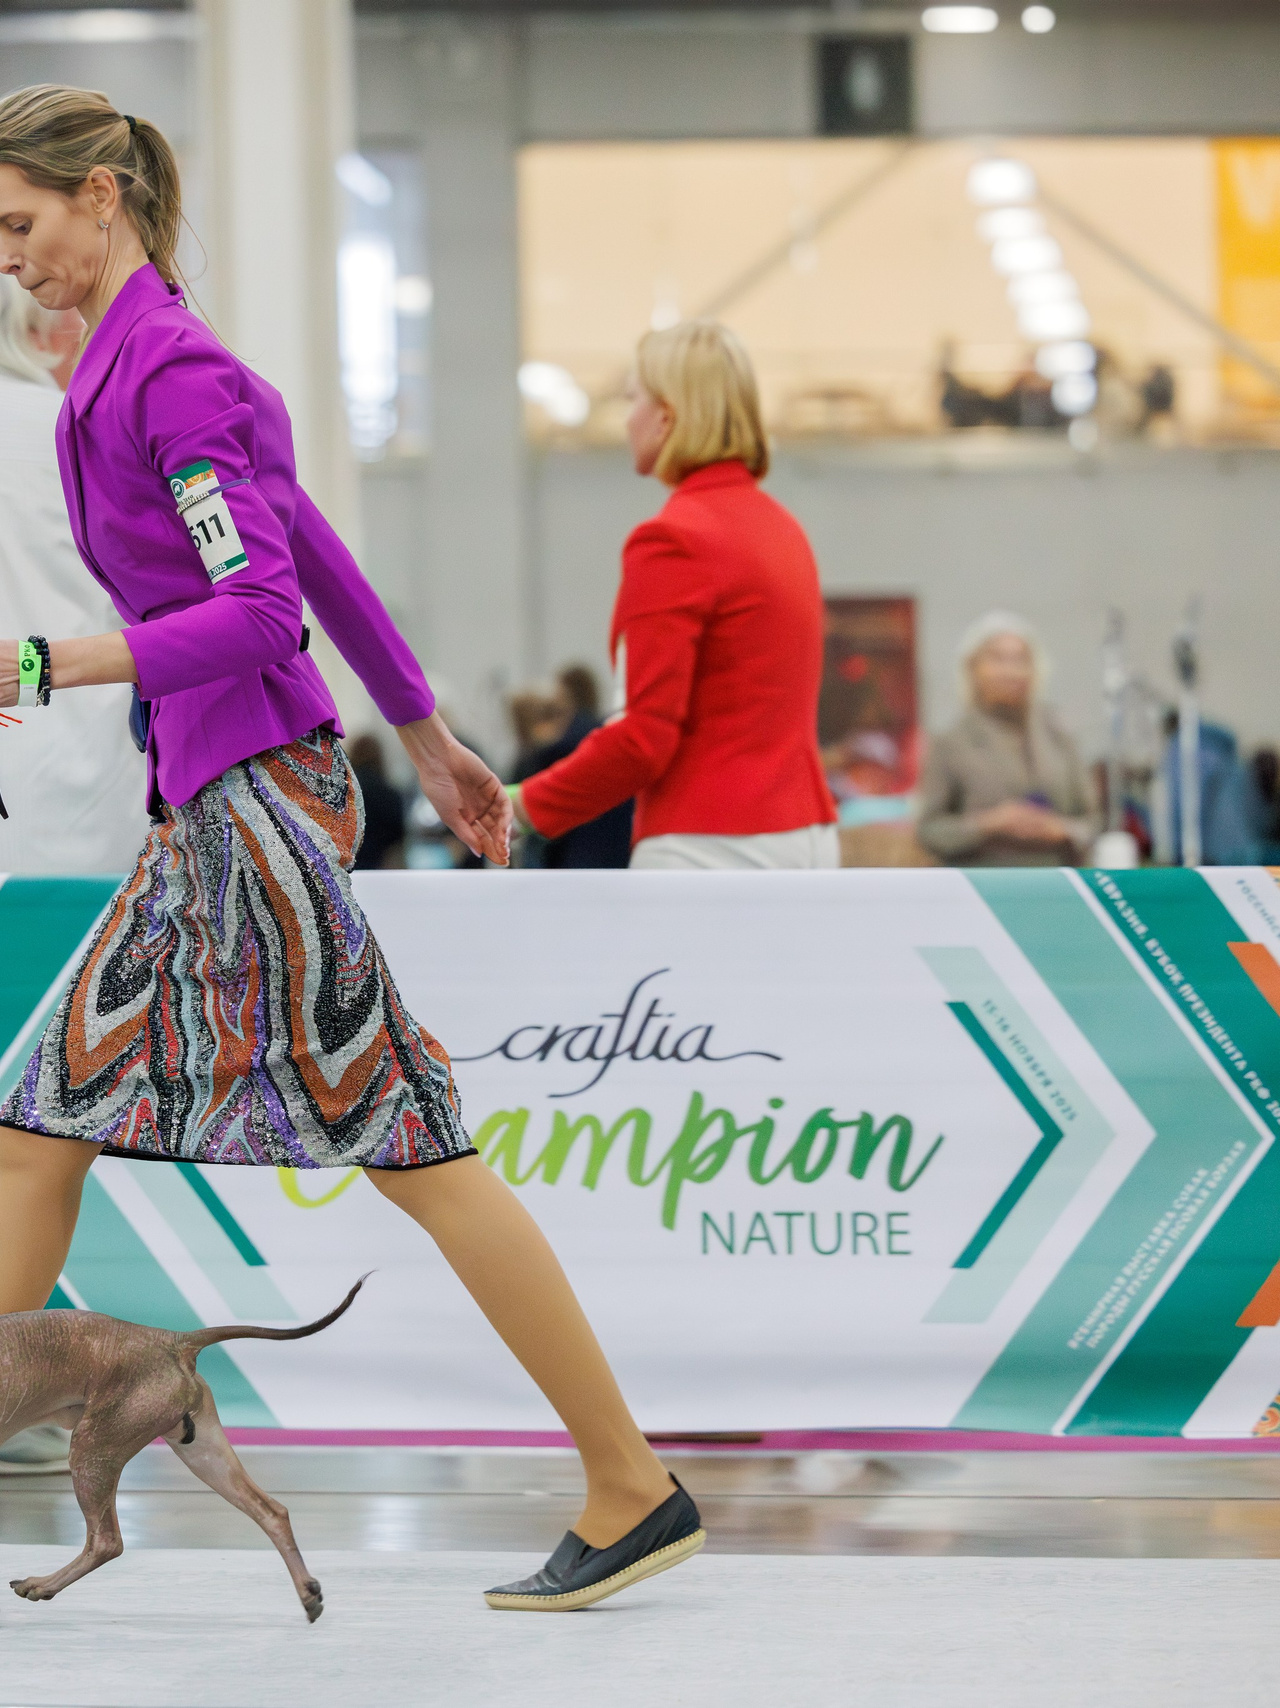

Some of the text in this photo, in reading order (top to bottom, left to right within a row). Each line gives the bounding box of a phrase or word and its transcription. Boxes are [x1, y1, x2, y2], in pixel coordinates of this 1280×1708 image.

[1236, 878, 1280, 940] РОССИЙС
[452, 968, 784, 1098] craftia
[1145, 938, 1184, 986] КУБОК
[1178, 983, 1248, 1072] ПРЕЗИДЕНТА
[1243, 1070, 1271, 1100] РКФ
[1008, 1033, 1053, 1088] НОЯБРЯ
[1049, 1090, 1077, 1121] 2025
[278, 1090, 945, 1231] ampion
[700, 1210, 914, 1256] NATURE
